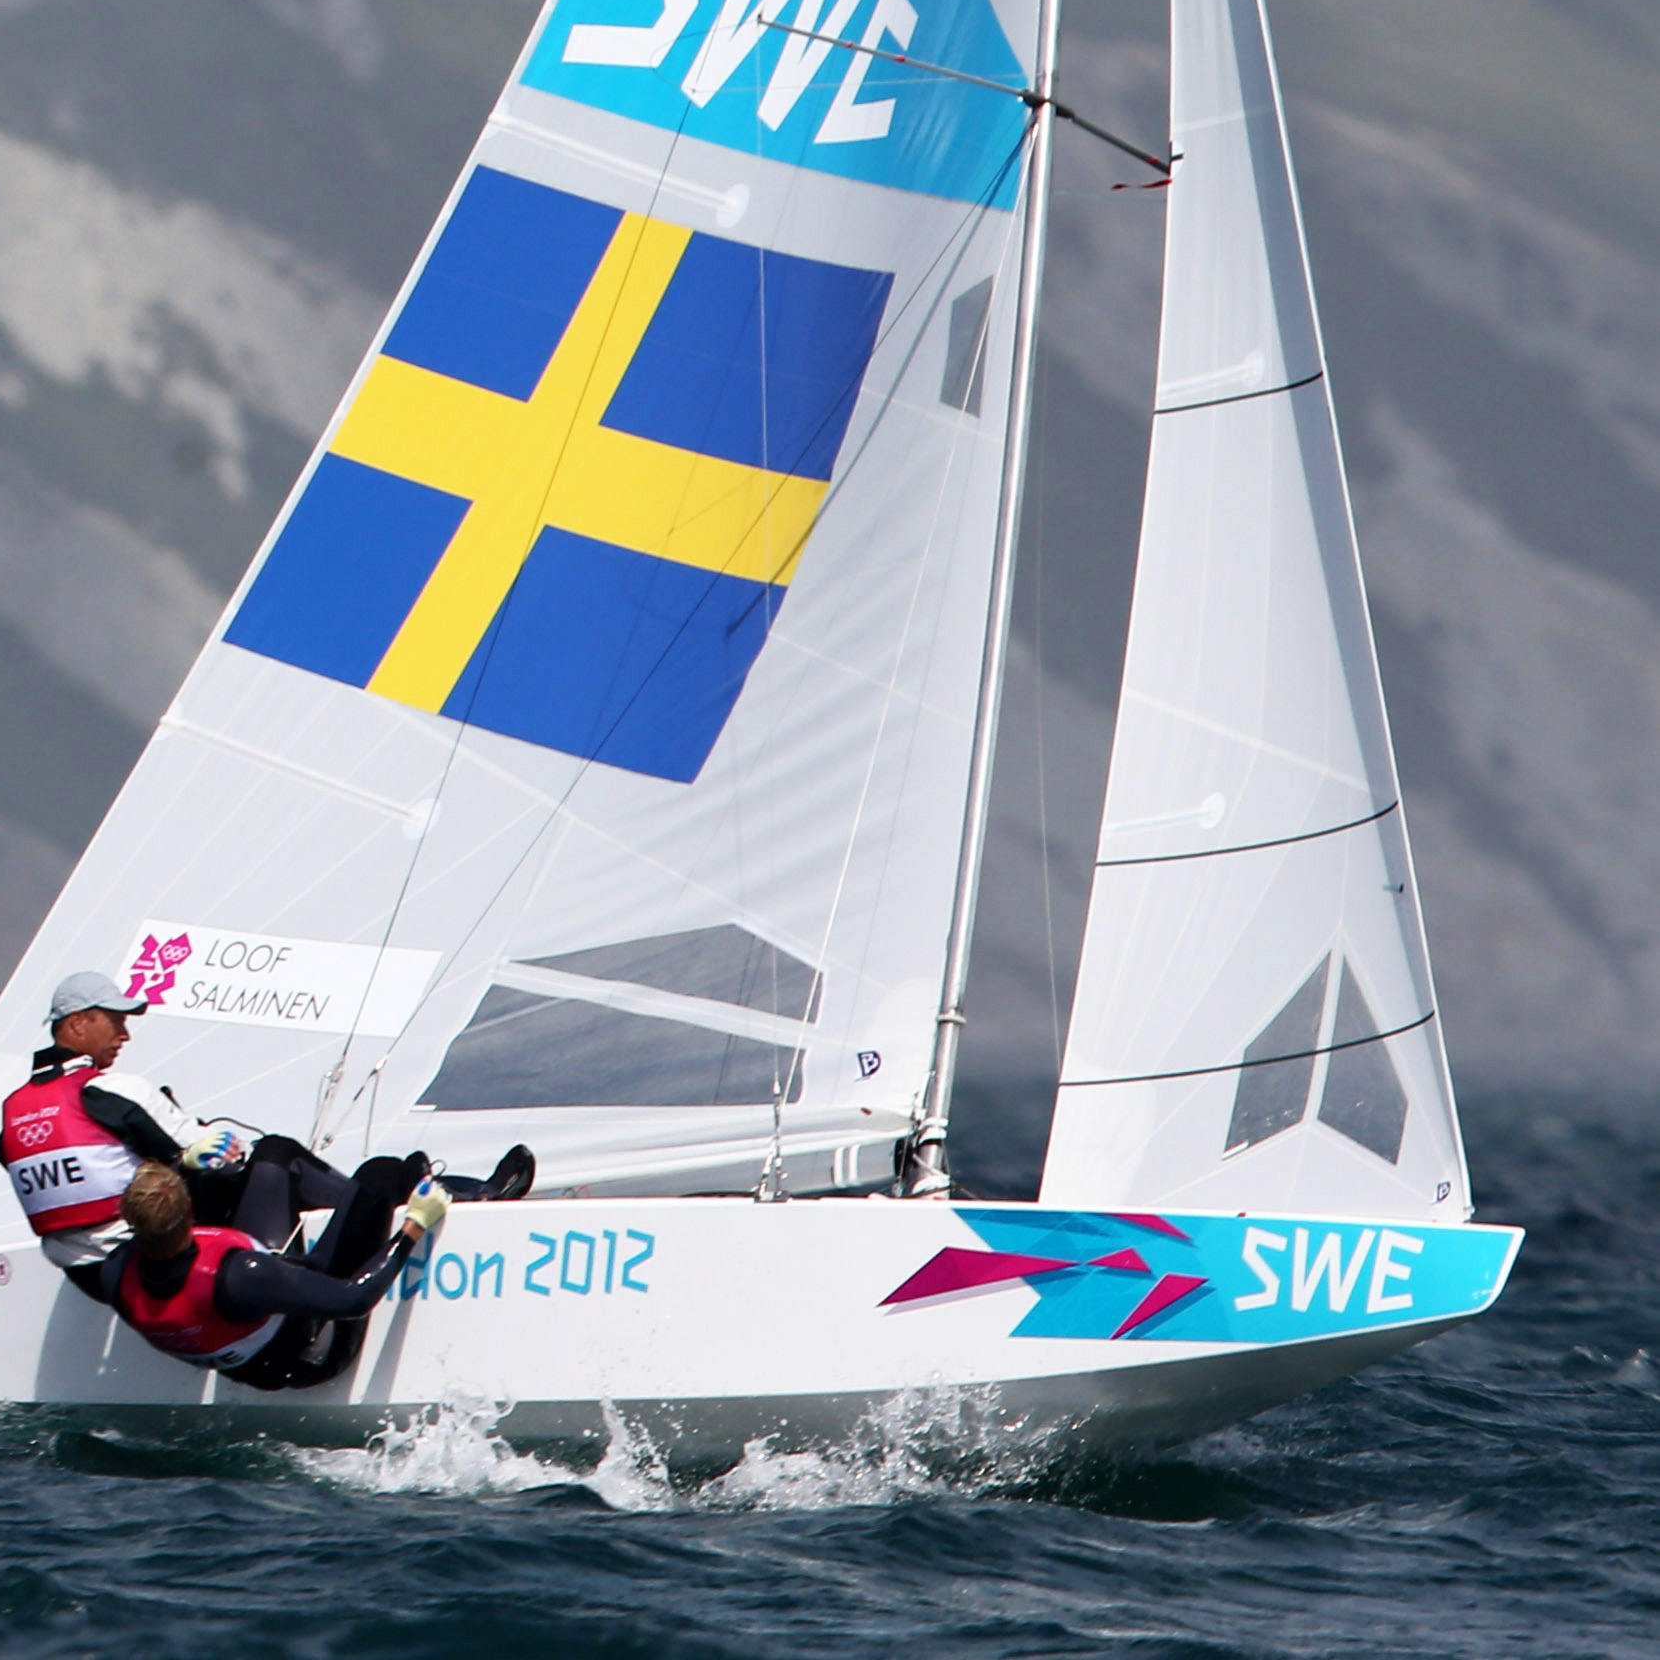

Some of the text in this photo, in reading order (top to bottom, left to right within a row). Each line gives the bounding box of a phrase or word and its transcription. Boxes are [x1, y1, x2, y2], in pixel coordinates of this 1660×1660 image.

[204, 939, 292, 973] LOOF
[183, 980, 331, 1022] SALMINEN
[18, 1156, 85, 1195] SWE
[524, 1228, 655, 1296] 2012
[1233, 1225, 1425, 1314] SWE
